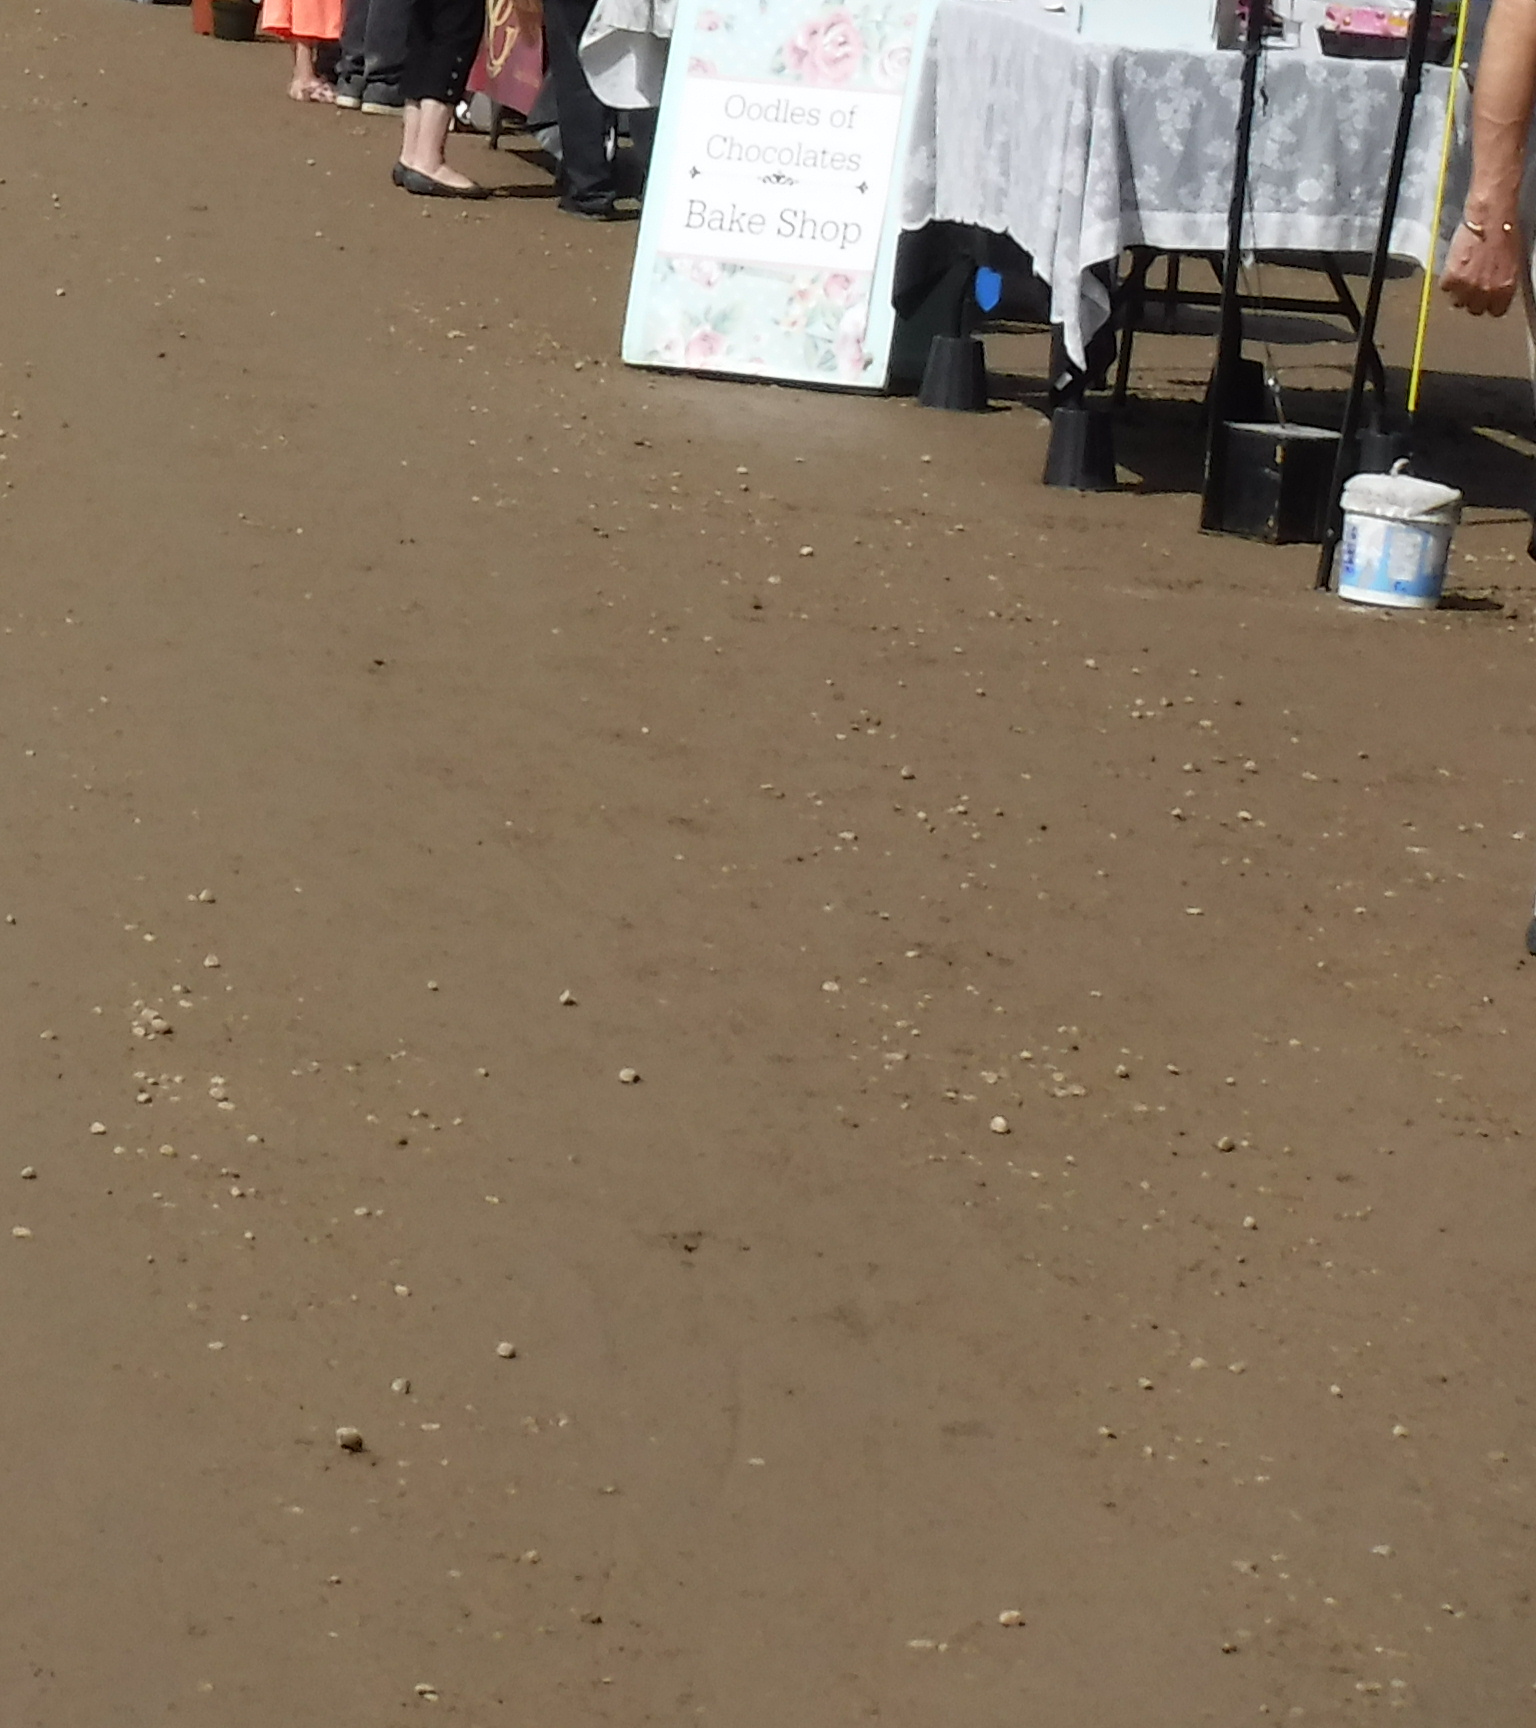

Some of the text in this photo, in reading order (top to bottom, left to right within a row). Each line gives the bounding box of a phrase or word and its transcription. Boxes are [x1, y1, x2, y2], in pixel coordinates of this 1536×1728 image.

[723, 93, 859, 130] Oodles of
[705, 133, 861, 172] Chocolates
[684, 198, 863, 250] Bake Shop
